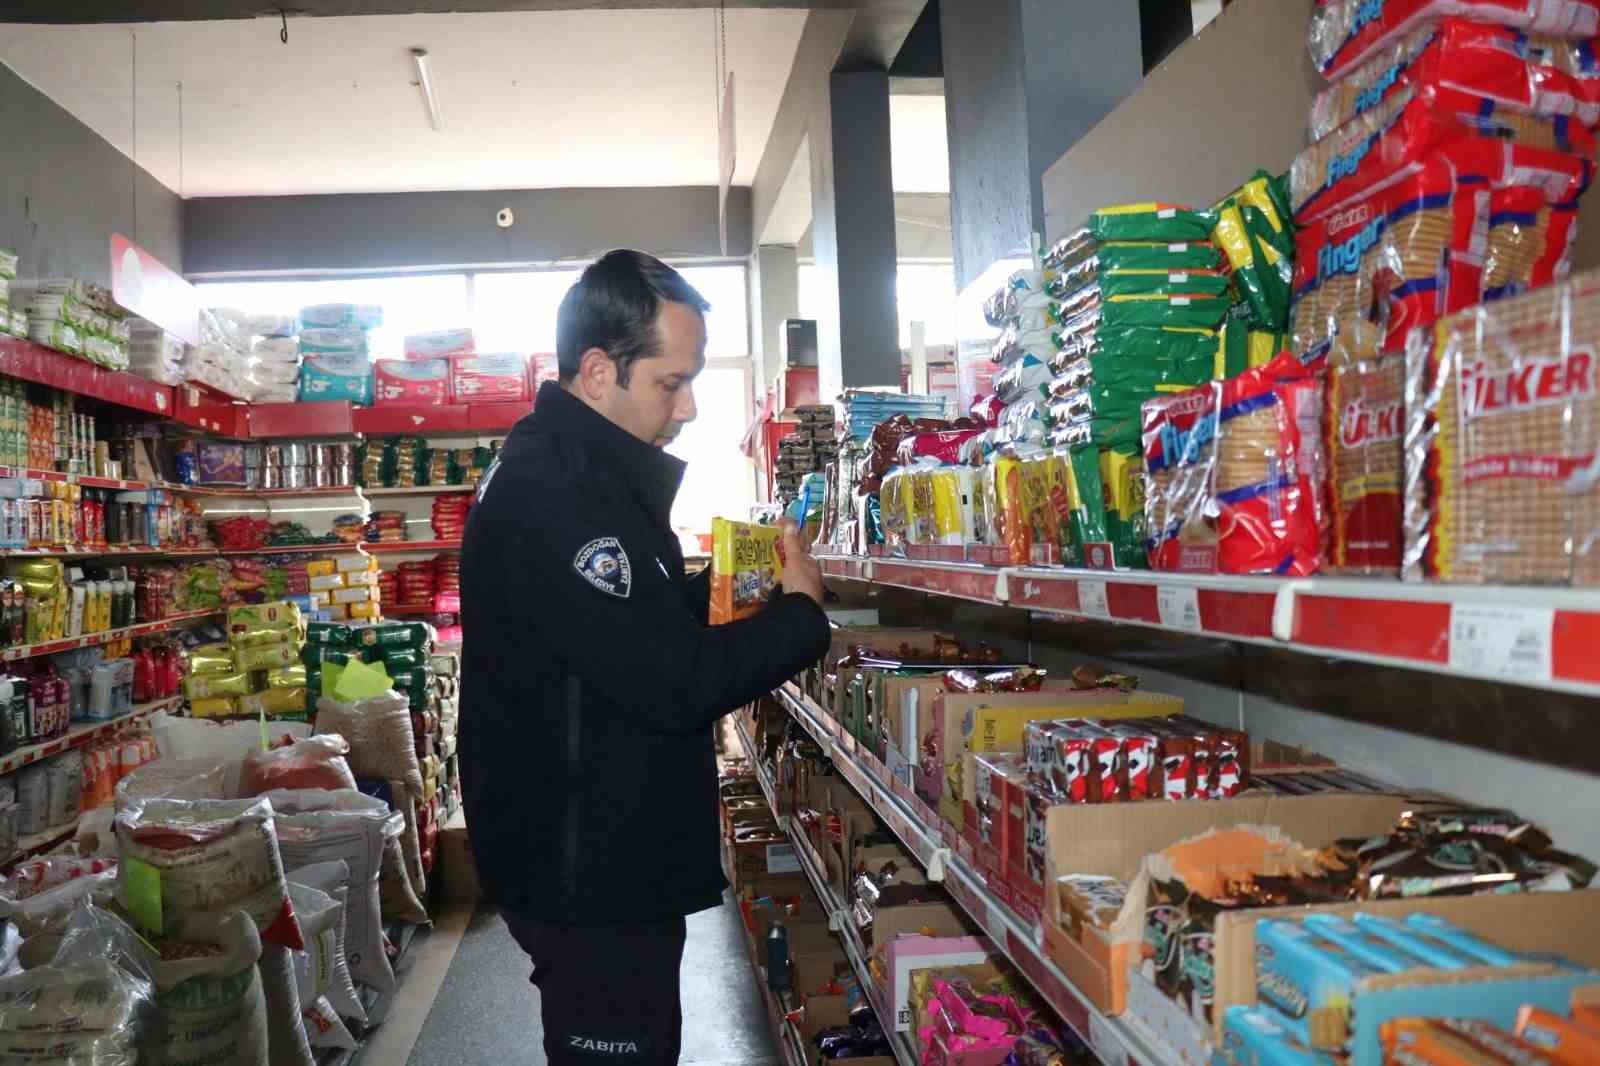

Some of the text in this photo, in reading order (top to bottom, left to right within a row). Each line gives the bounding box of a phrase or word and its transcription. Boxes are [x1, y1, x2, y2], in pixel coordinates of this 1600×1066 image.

[1318, 216, 1385, 278] Finger
[1462, 351, 1592, 420] ÜLKER
[569, 1035, 638, 1053] ZABITA
